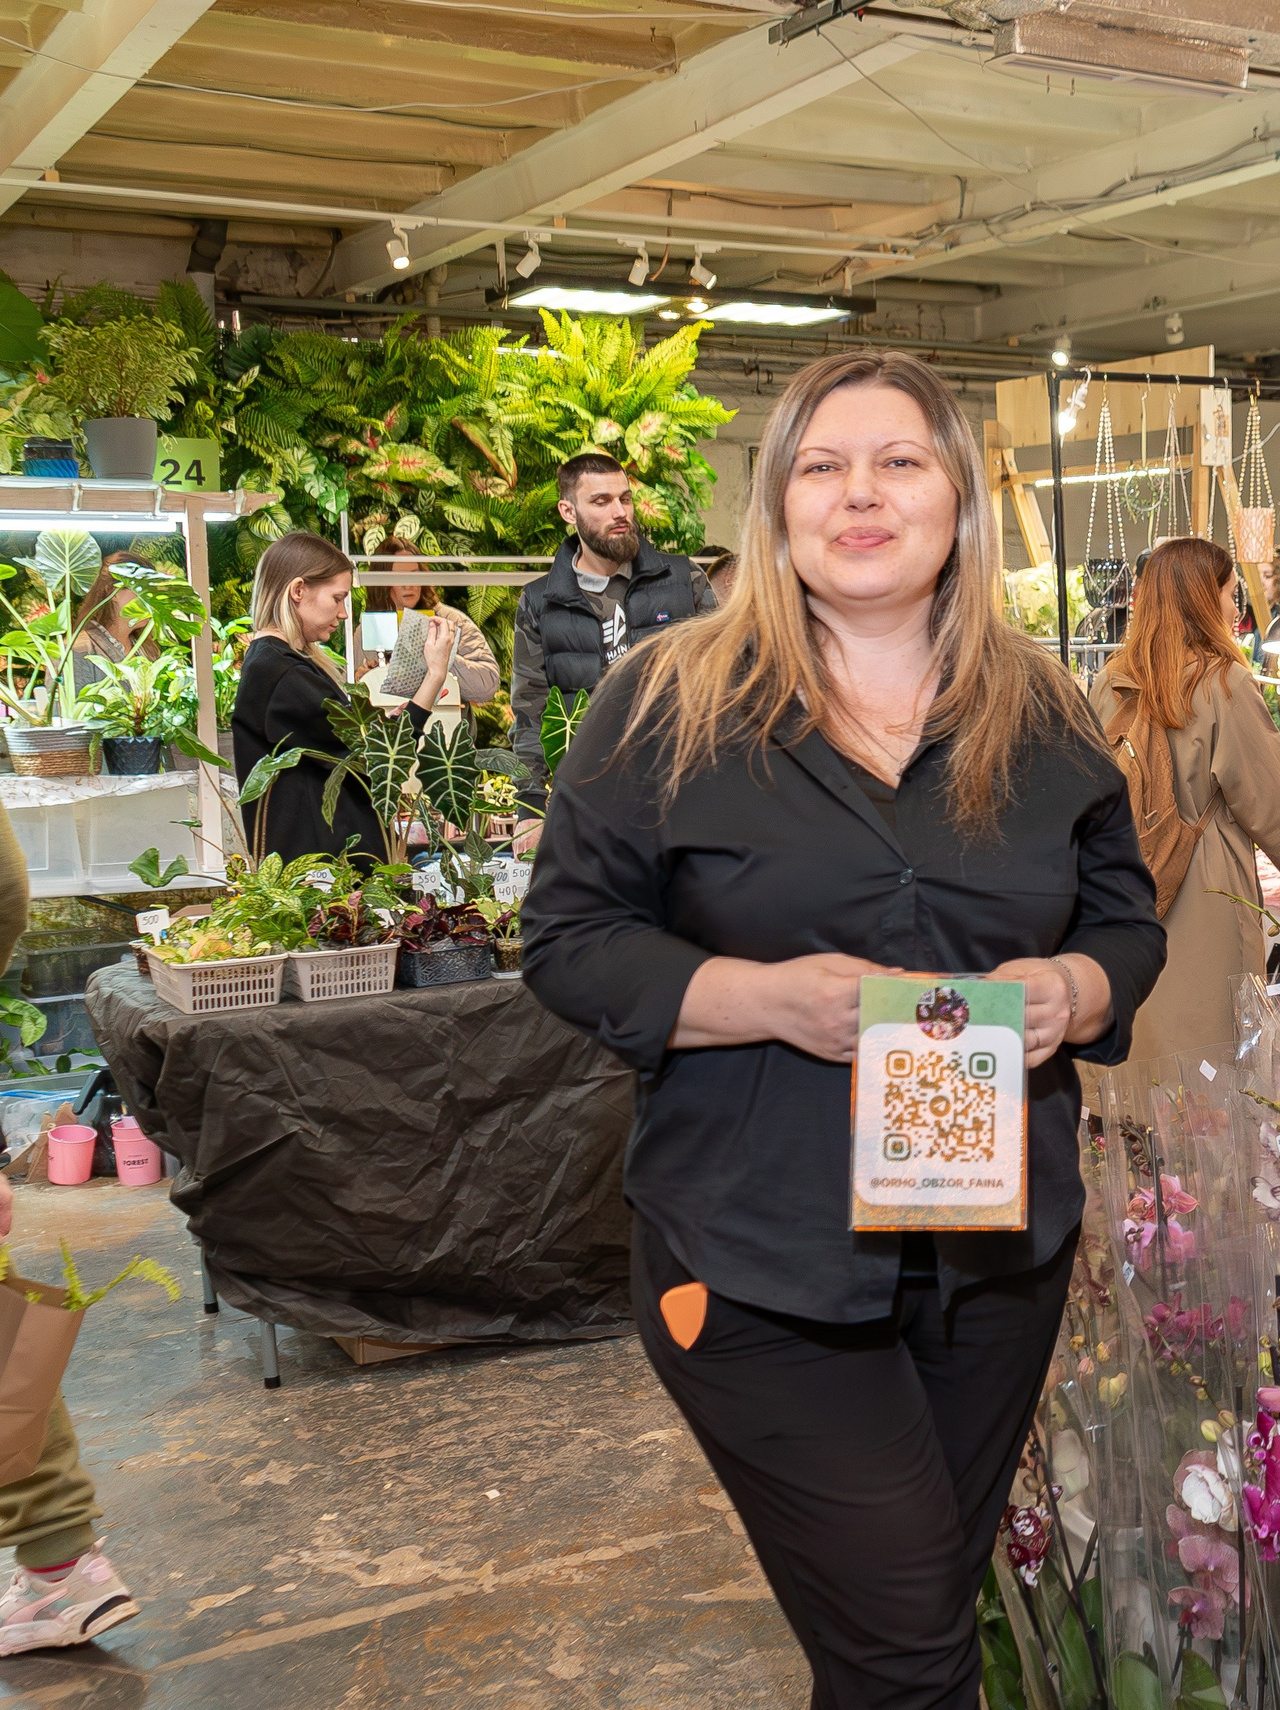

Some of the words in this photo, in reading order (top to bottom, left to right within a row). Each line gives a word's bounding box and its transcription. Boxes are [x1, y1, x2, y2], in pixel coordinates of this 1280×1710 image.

[159, 458, 206, 486] 24
[512, 868, 531, 878] 500
[417, 875, 436, 884] 350
[498, 884, 518, 897] 400
[141, 914, 159, 926] 500
